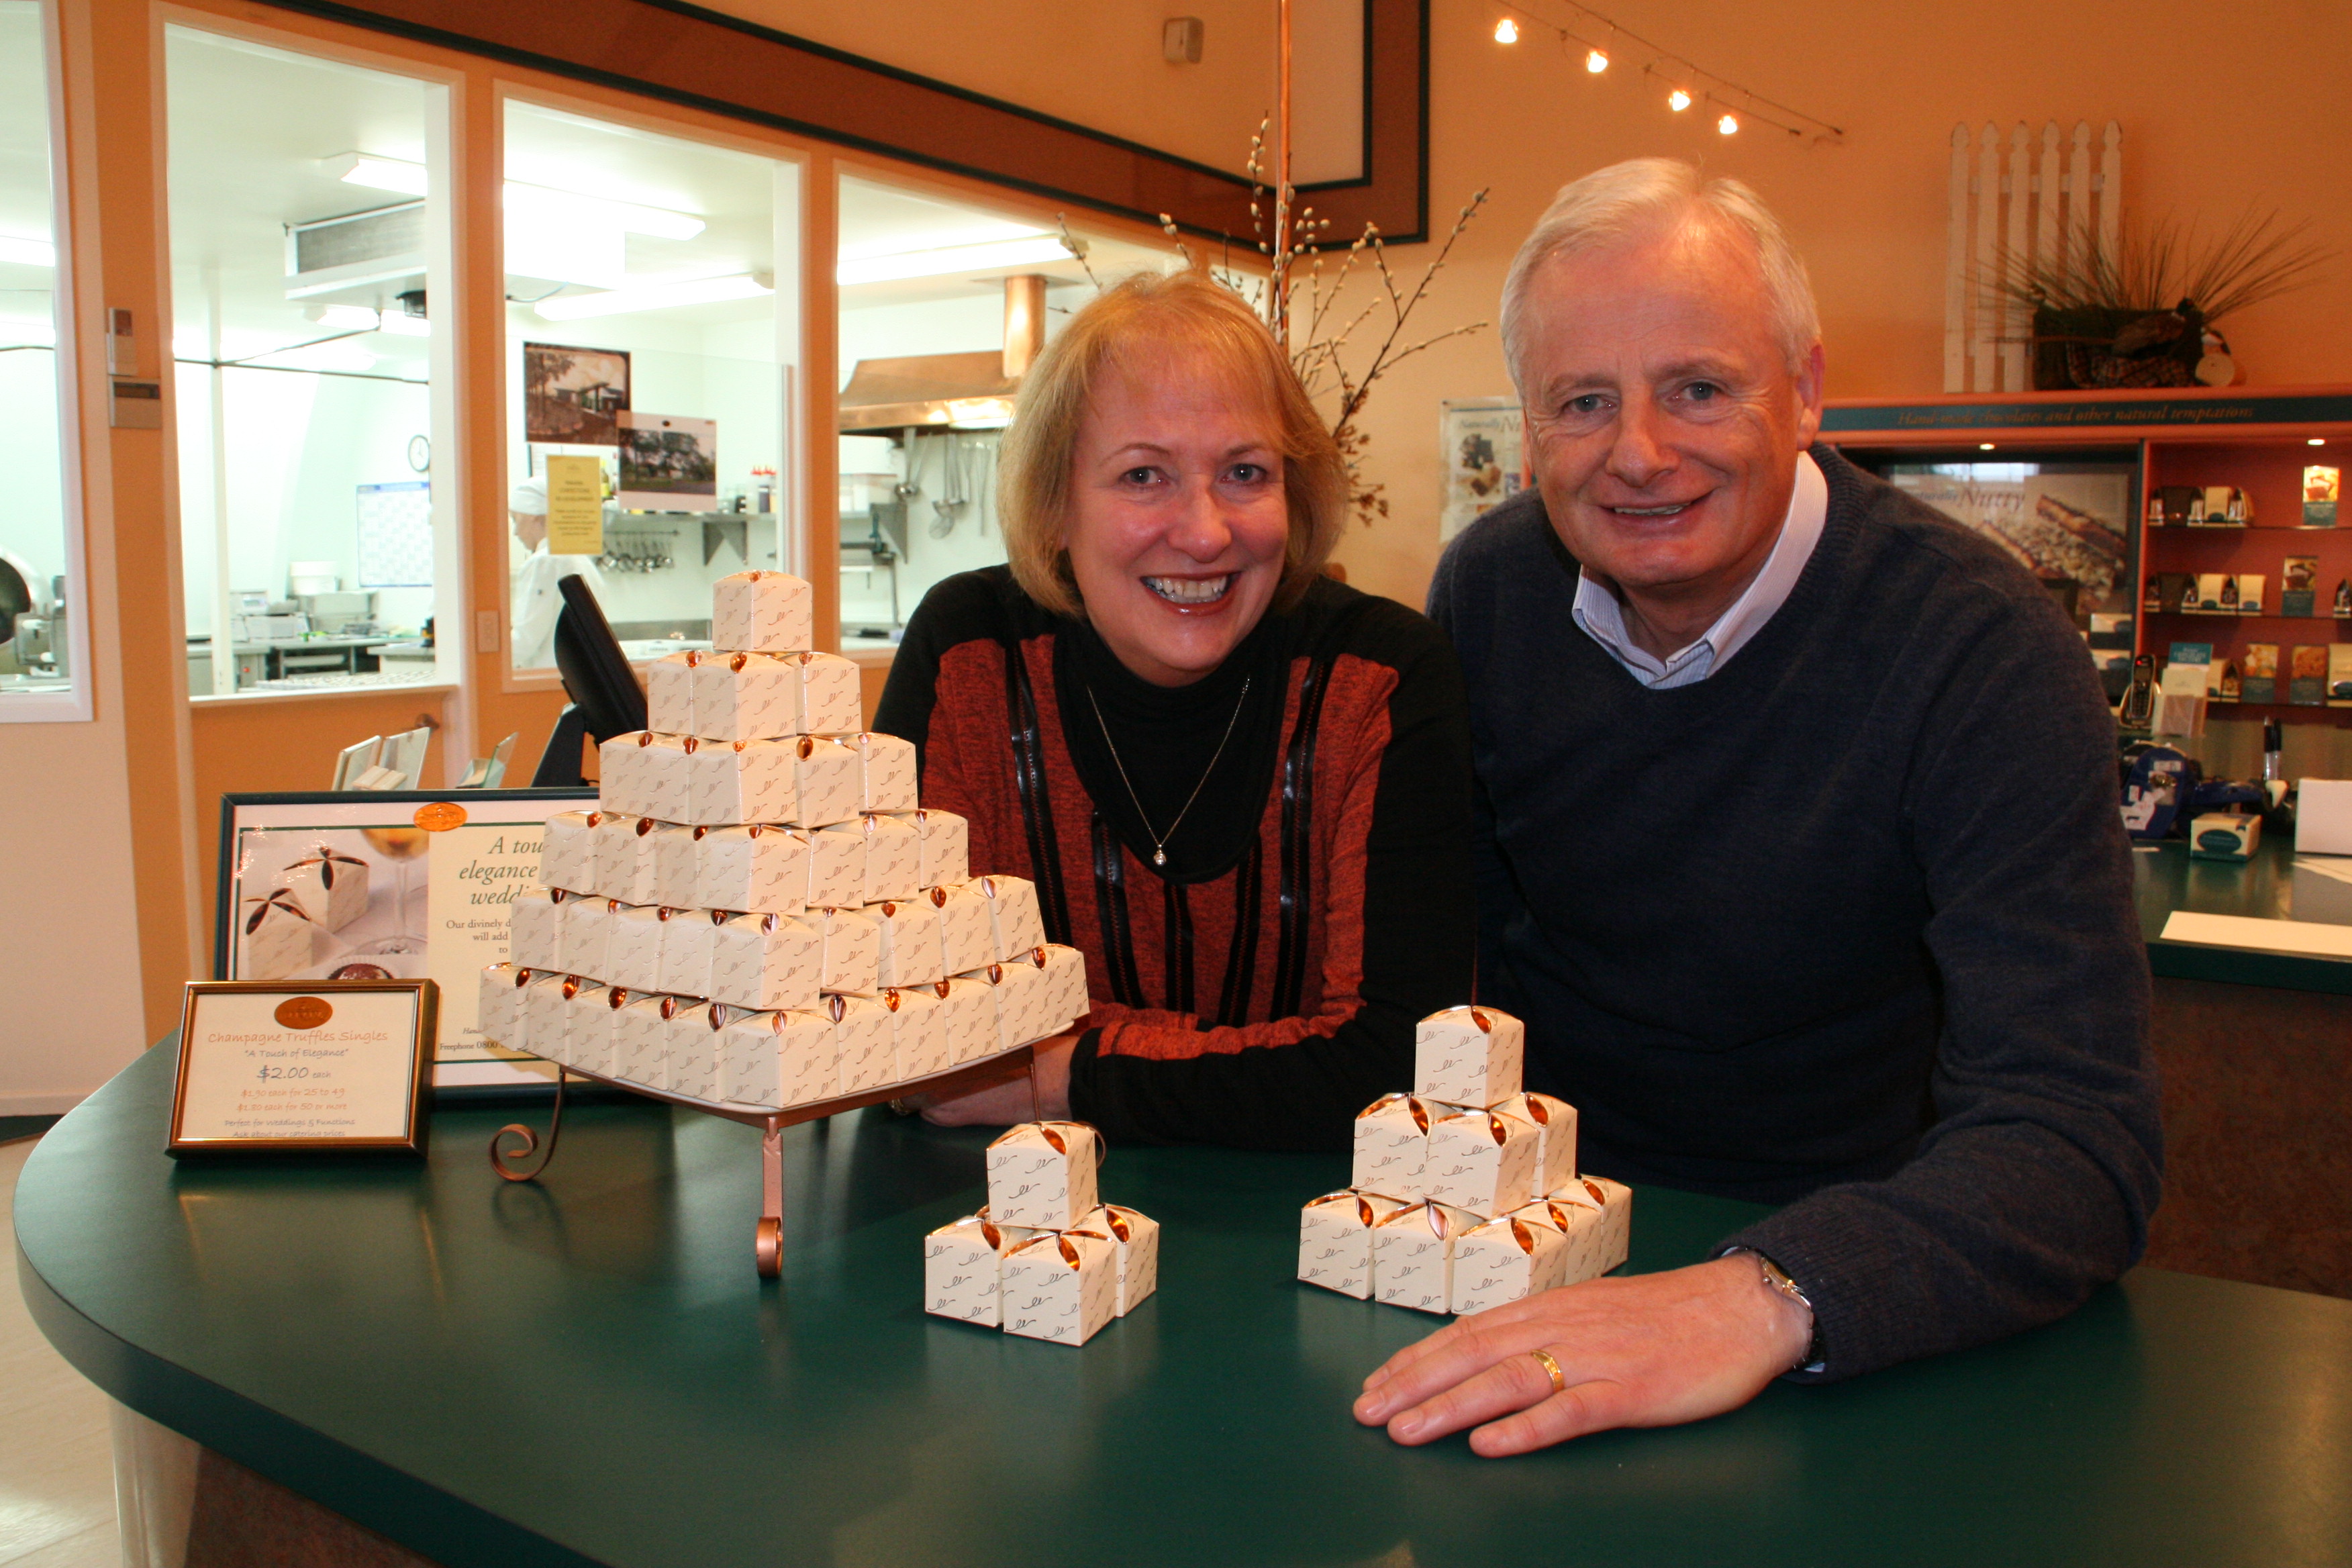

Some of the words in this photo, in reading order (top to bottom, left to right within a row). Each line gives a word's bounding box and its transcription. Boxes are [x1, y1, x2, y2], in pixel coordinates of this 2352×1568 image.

[2045, 406, 2075, 422] and
[2076, 406, 2112, 421] other
[2116, 405, 2169, 420] natural
[2170, 405, 2255, 424] temptations
[1959, 486, 2025, 512] Nutty
[488, 836, 505, 854] A
[512, 840, 544, 854] tou
[458, 859, 538, 885] elegance
[471, 884, 529, 904] wedd
[446, 920, 464, 929] Our
[467, 918, 503, 930] divinely
[473, 932, 489, 941] will
[492, 931, 509, 941] add
[499, 946, 508, 954] to
[208, 1033, 282, 1046] Champagne
[285, 1030, 335, 1045] Truffles
[338, 1030, 388, 1044] Singles
[476, 1040, 497, 1048] 0800
[259, 1048, 287, 1058] Touch
[290, 1047, 301, 1059] of
[256, 1065, 309, 1083] $2.00
[312, 1071, 331, 1079] each
[268, 1088, 287, 1097] each
[289, 1087, 301, 1099] for
[303, 1088, 318, 1096] 25
[331, 1087, 345, 1099] 49
[264, 1103, 283, 1111] each
[285, 1101, 298, 1113] for
